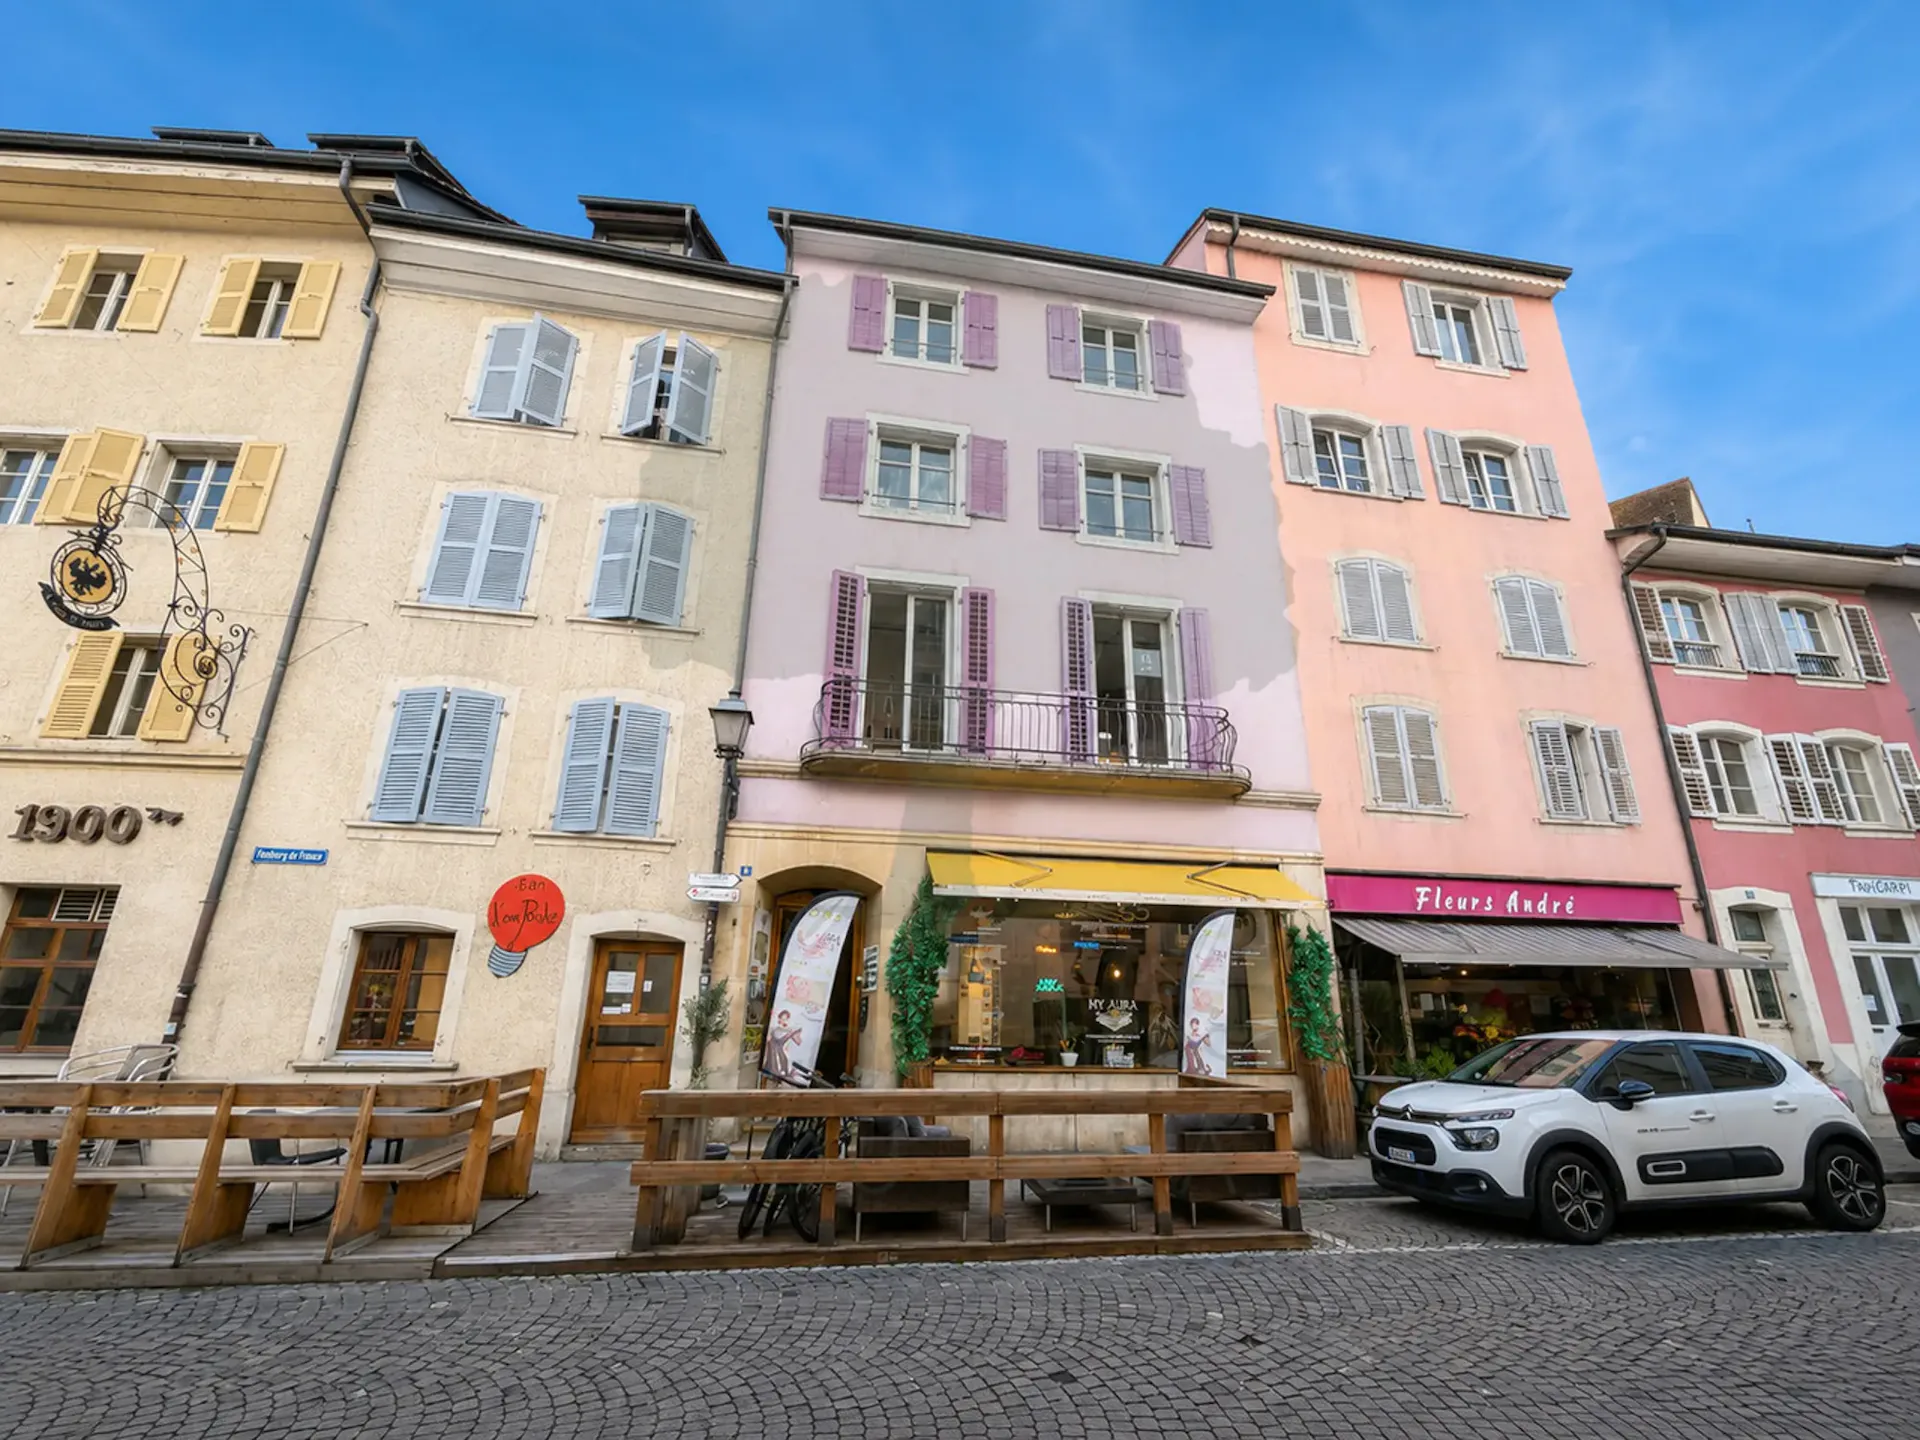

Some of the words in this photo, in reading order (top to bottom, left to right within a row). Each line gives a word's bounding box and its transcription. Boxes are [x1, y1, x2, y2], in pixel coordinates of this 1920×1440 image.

[8, 804, 143, 845] 1900
[1415, 886, 1493, 911] Fleurs
[1506, 889, 1575, 914] André
